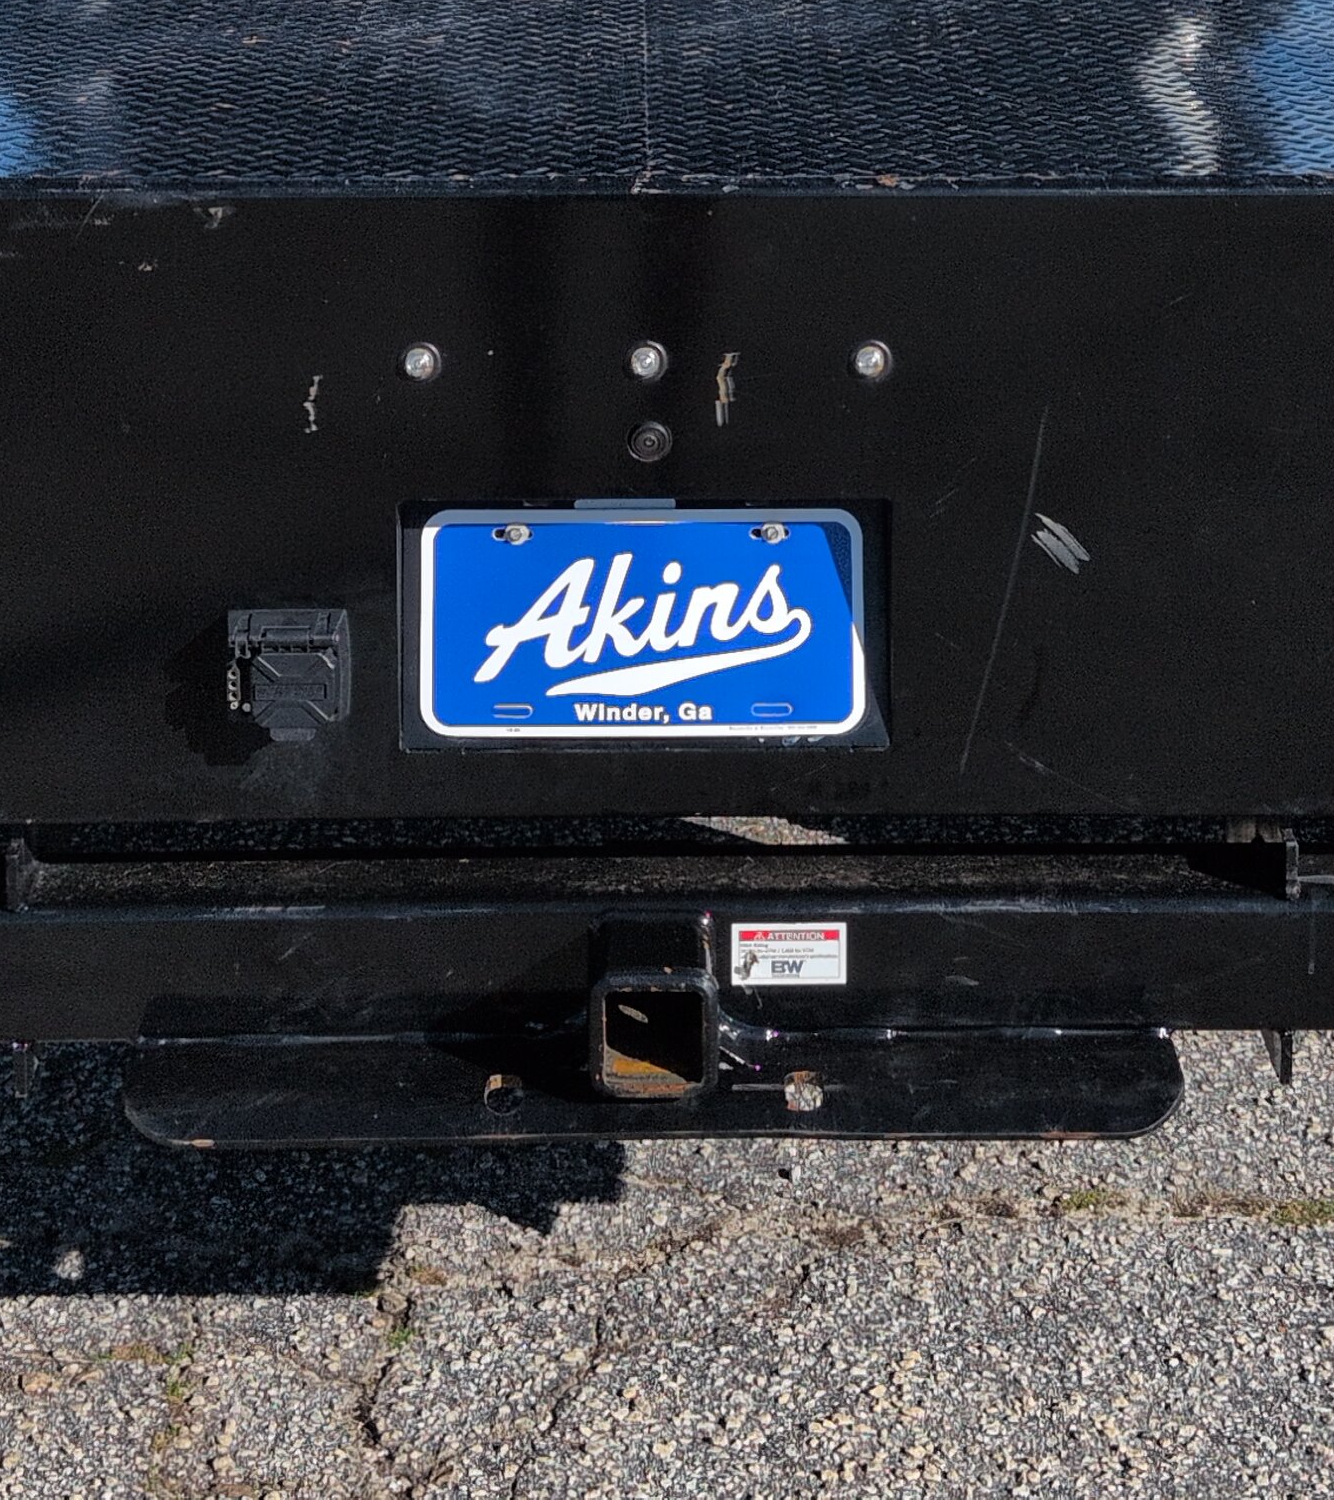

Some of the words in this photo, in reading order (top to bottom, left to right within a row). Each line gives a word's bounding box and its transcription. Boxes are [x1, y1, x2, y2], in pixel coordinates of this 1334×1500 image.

[474, 552, 812, 684] Akins
[573, 702, 671, 725] Winder,
[678, 702, 713, 721] Ga
[767, 931, 825, 940] ATTENTION
